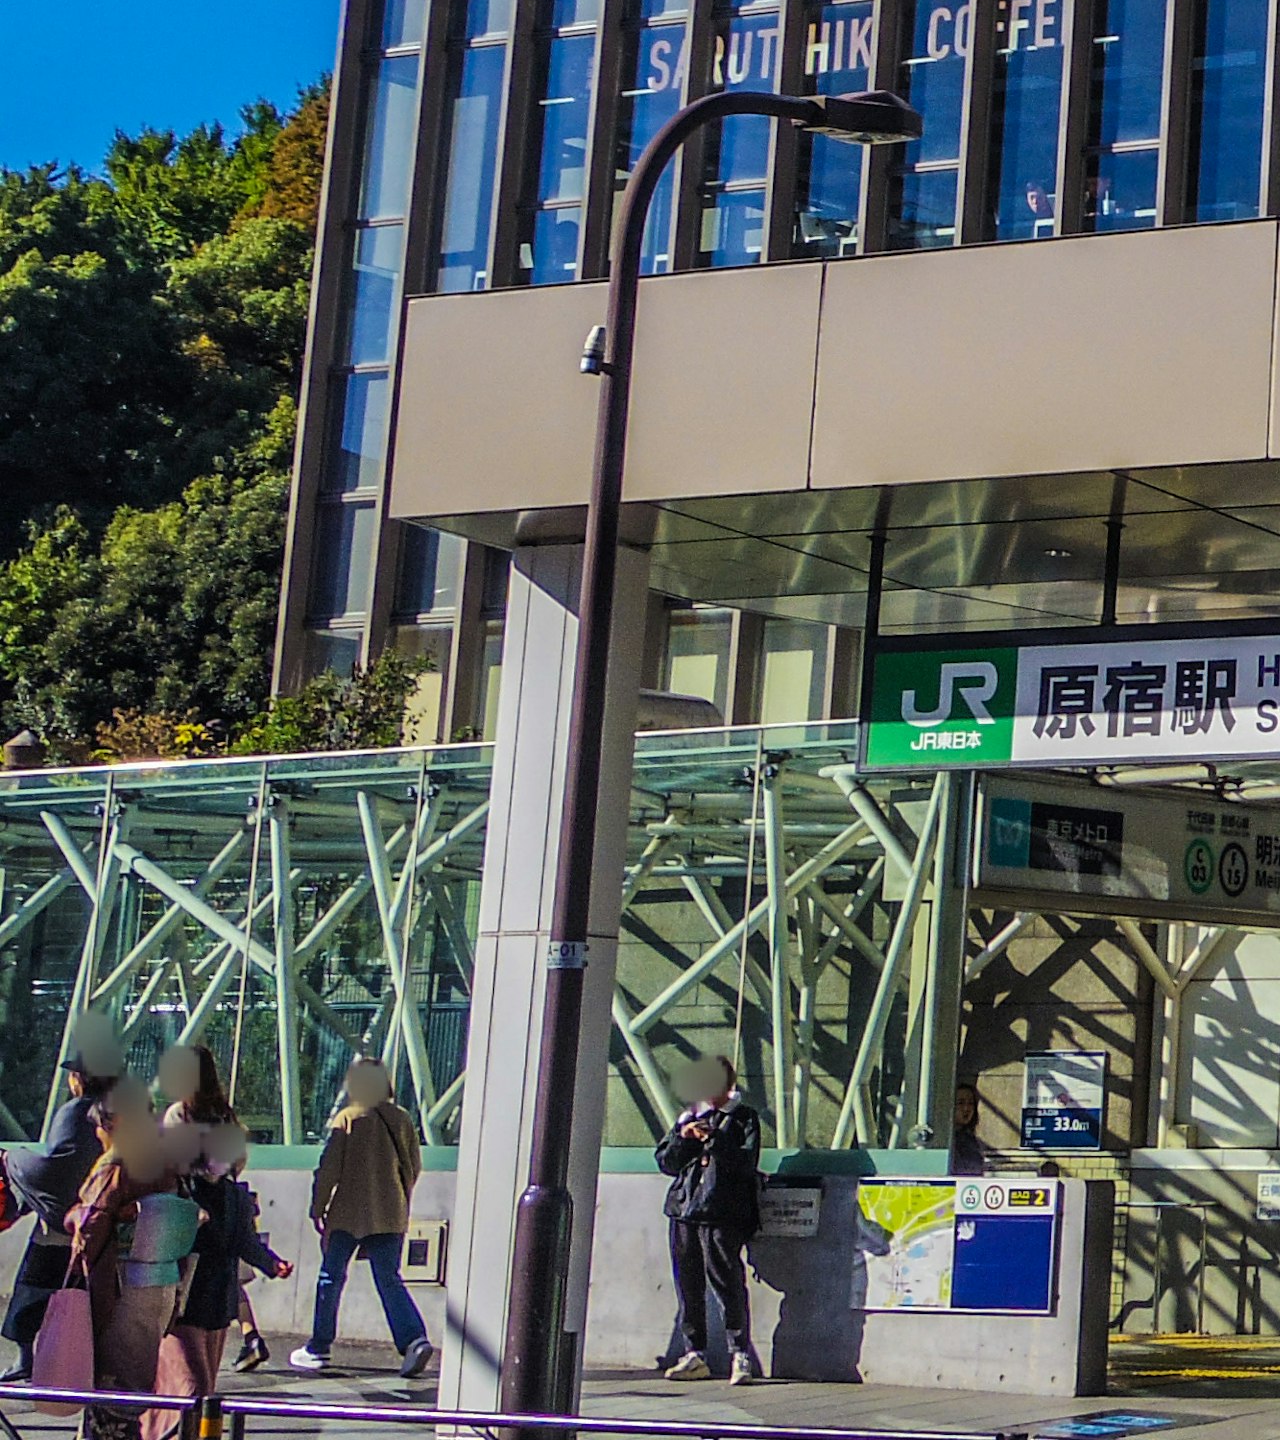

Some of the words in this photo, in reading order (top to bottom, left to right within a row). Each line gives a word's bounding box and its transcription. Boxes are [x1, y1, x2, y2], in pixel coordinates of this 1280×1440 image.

[901, 661, 998, 728] JR
[1032, 658, 1238, 740] 原宿駅
[910, 729, 981, 751] JR東日本
[1046, 819, 1107, 843] 東京メトロ
[1191, 866, 1207, 883] 03
[1227, 868, 1242, 886] 15
[1034, 1190, 1046, 1206] 2
